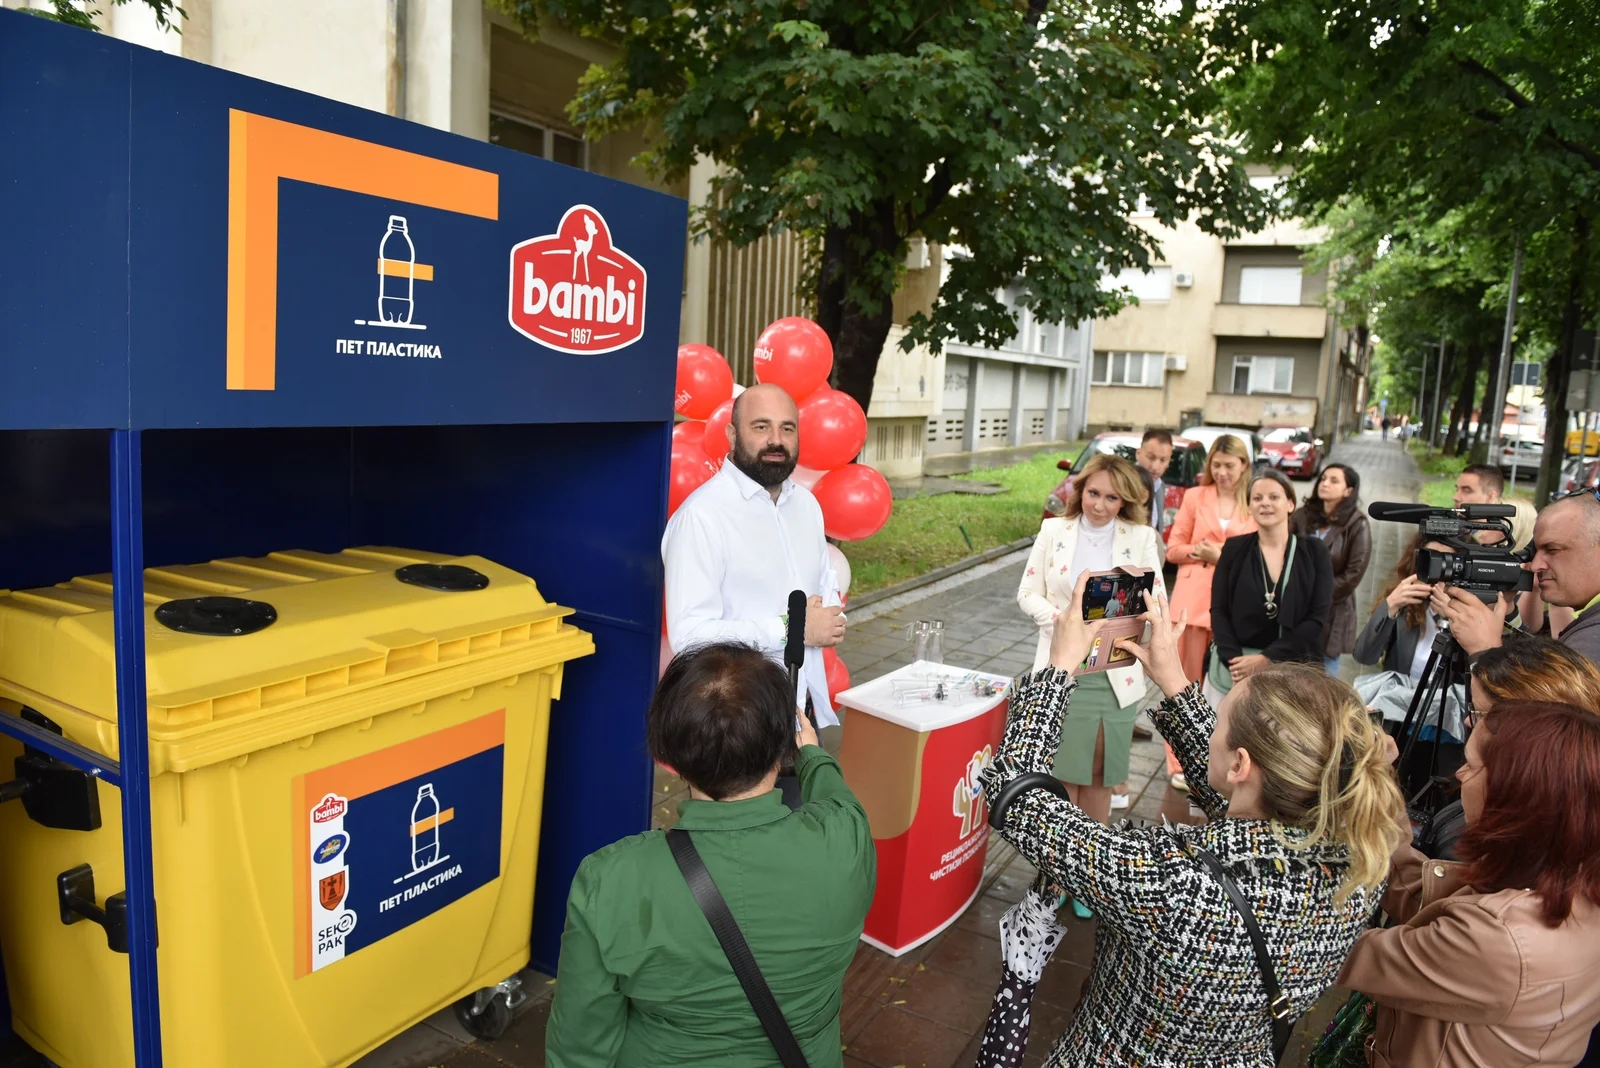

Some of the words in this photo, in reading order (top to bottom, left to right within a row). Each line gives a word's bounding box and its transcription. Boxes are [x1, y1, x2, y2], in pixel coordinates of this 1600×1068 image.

[523, 261, 636, 325] bambi
[571, 327, 592, 344] 1967
[336, 339, 364, 354] ПЕТ
[366, 341, 442, 359] ПЛАСТИКА
[315, 803, 343, 821] bambi
[380, 893, 402, 913] ПЕТ
[404, 864, 462, 901] ПЛАСТИКА
[318, 935, 343, 954] PAK
